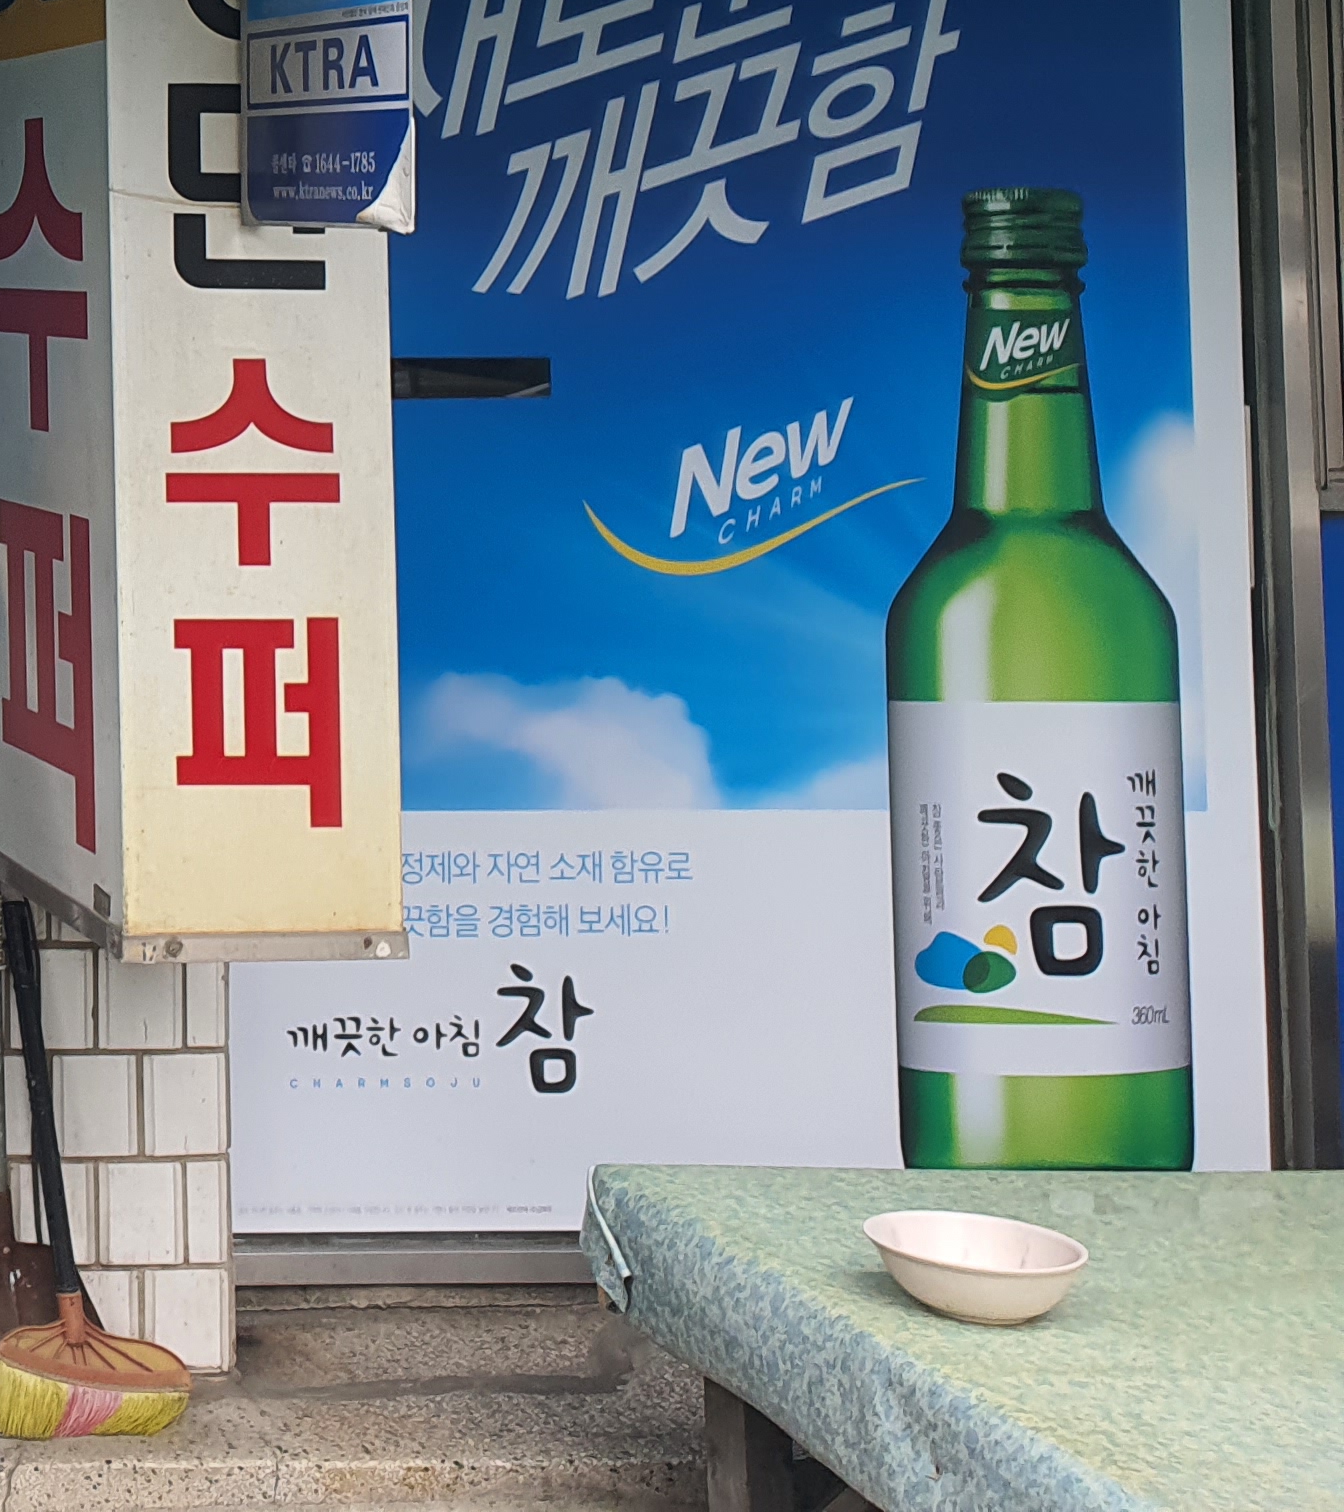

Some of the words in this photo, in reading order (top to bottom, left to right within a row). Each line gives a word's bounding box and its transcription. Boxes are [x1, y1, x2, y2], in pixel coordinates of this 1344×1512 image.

[269, 33, 379, 96] KTRA
[273, 180, 373, 200] www.ktranews.co.kr
[316, 151, 375, 173] 1644-1785
[979, 316, 1071, 372] New
[999, 354, 1054, 380] CHARM
[669, 396, 854, 539] New
[718, 476, 824, 545] CHARM
[165, 358, 342, 828] 수퍼
[1126, 769, 1159, 888] 깨끗한
[402, 851, 480, 884] 정제와
[487, 851, 540, 884] 자연
[549, 852, 603, 884] 소재
[611, 852, 694, 883] 함유로
[977, 771, 1126, 976] 참
[403, 904, 481, 938] 끗함을
[488, 903, 570, 938] 경험해
[577, 904, 671, 937] 보세요!
[1136, 904, 1162, 975] 아침
[287, 1017, 401, 1058] 깨끗한
[413, 1014, 481, 1058] 아침
[495, 963, 595, 1094] 참
